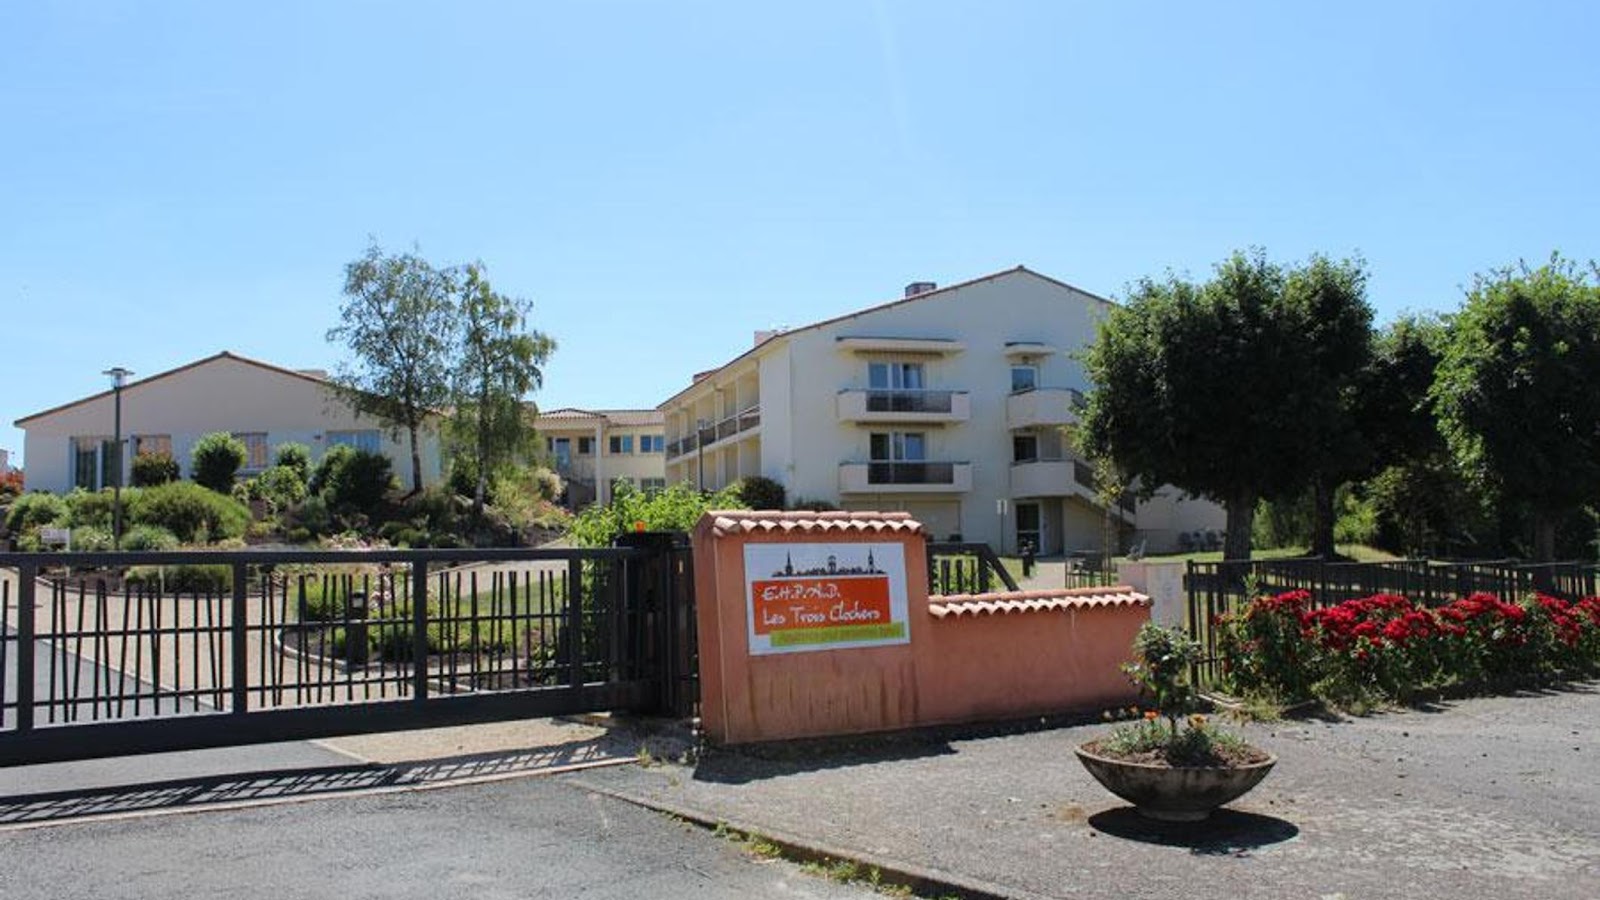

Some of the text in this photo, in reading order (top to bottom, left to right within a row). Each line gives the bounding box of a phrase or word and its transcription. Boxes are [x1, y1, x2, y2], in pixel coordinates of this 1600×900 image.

[762, 601, 880, 625] Les Trois Clochers
